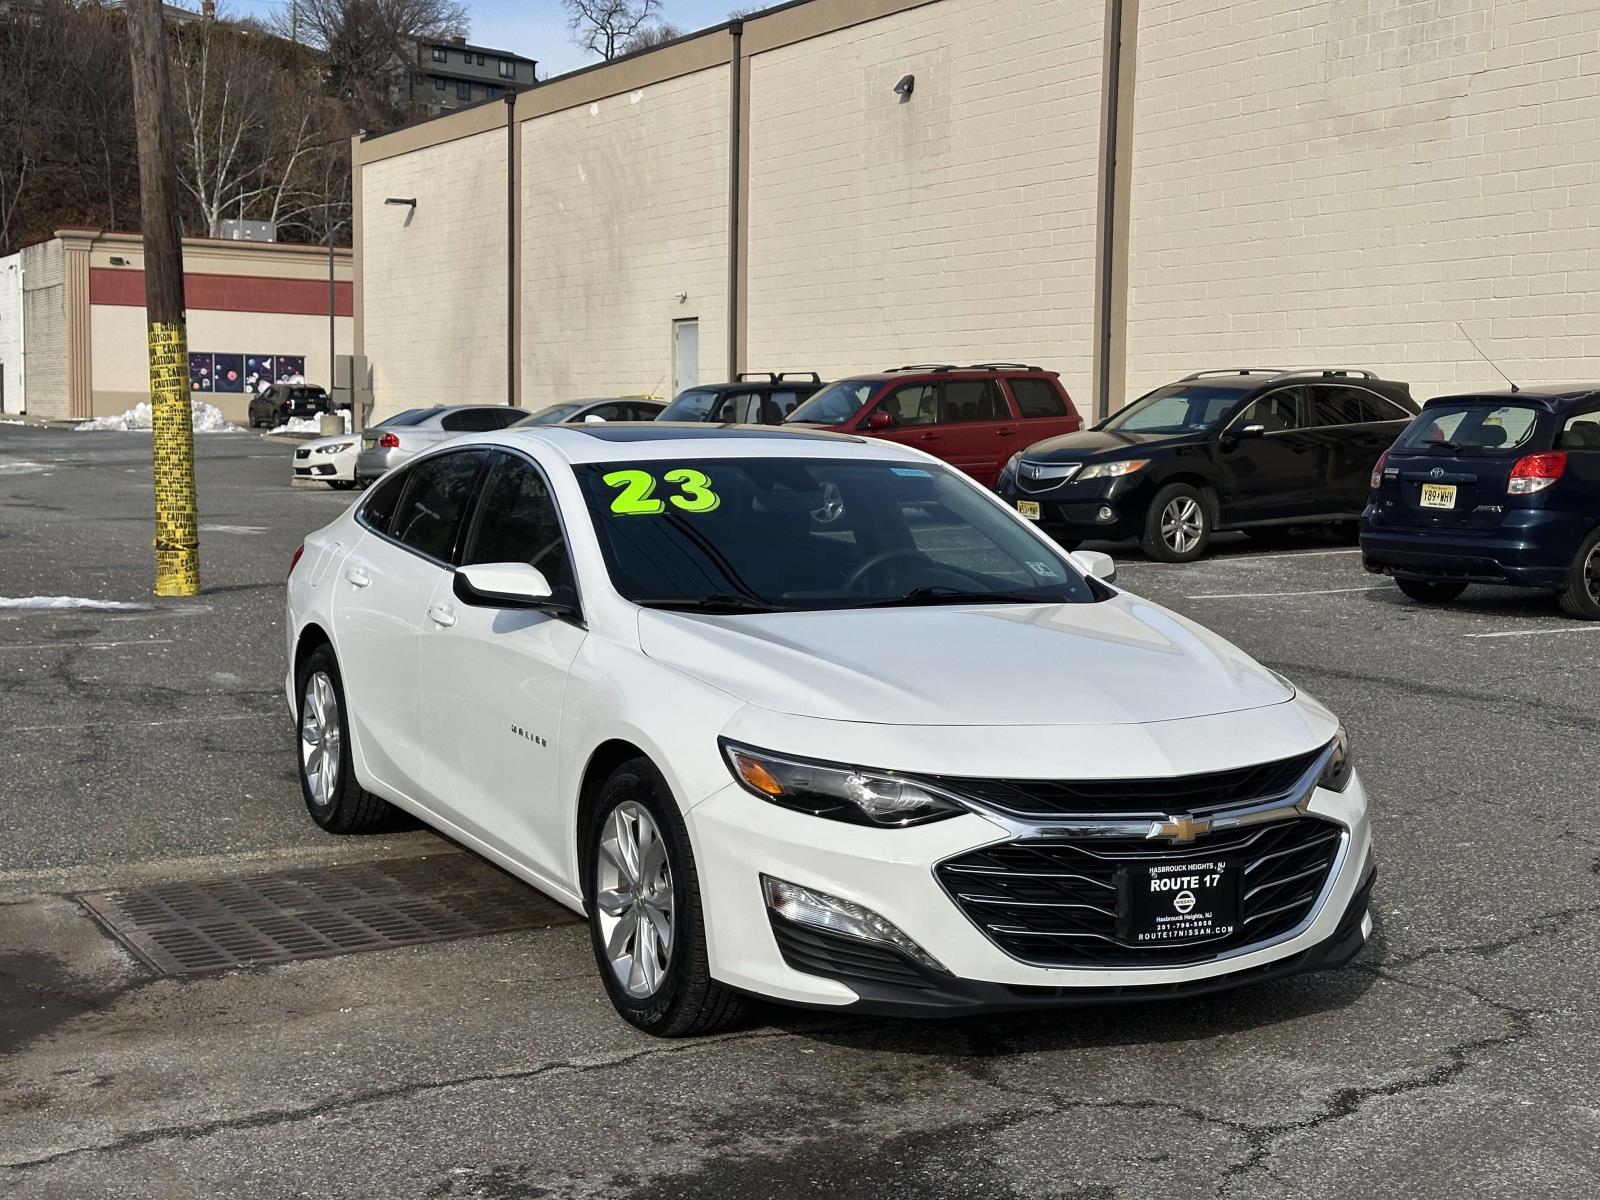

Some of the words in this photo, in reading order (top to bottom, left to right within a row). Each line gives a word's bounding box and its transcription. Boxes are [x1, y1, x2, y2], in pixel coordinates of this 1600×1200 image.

[154, 378, 181, 388] CAUTION
[602, 468, 720, 515] 23
[167, 512, 193, 521] CAUTION
[1149, 865, 1187, 873] HASBROUCK
[1217, 861, 1226, 869] NJ
[1150, 876, 1199, 892] ROUTE
[1204, 874, 1220, 887] 17
[1156, 915, 1183, 923] Hasbrouck
[1184, 913, 1205, 921] Heights,
[1138, 926, 1234, 940] ROUTE17NISSAN.COM
